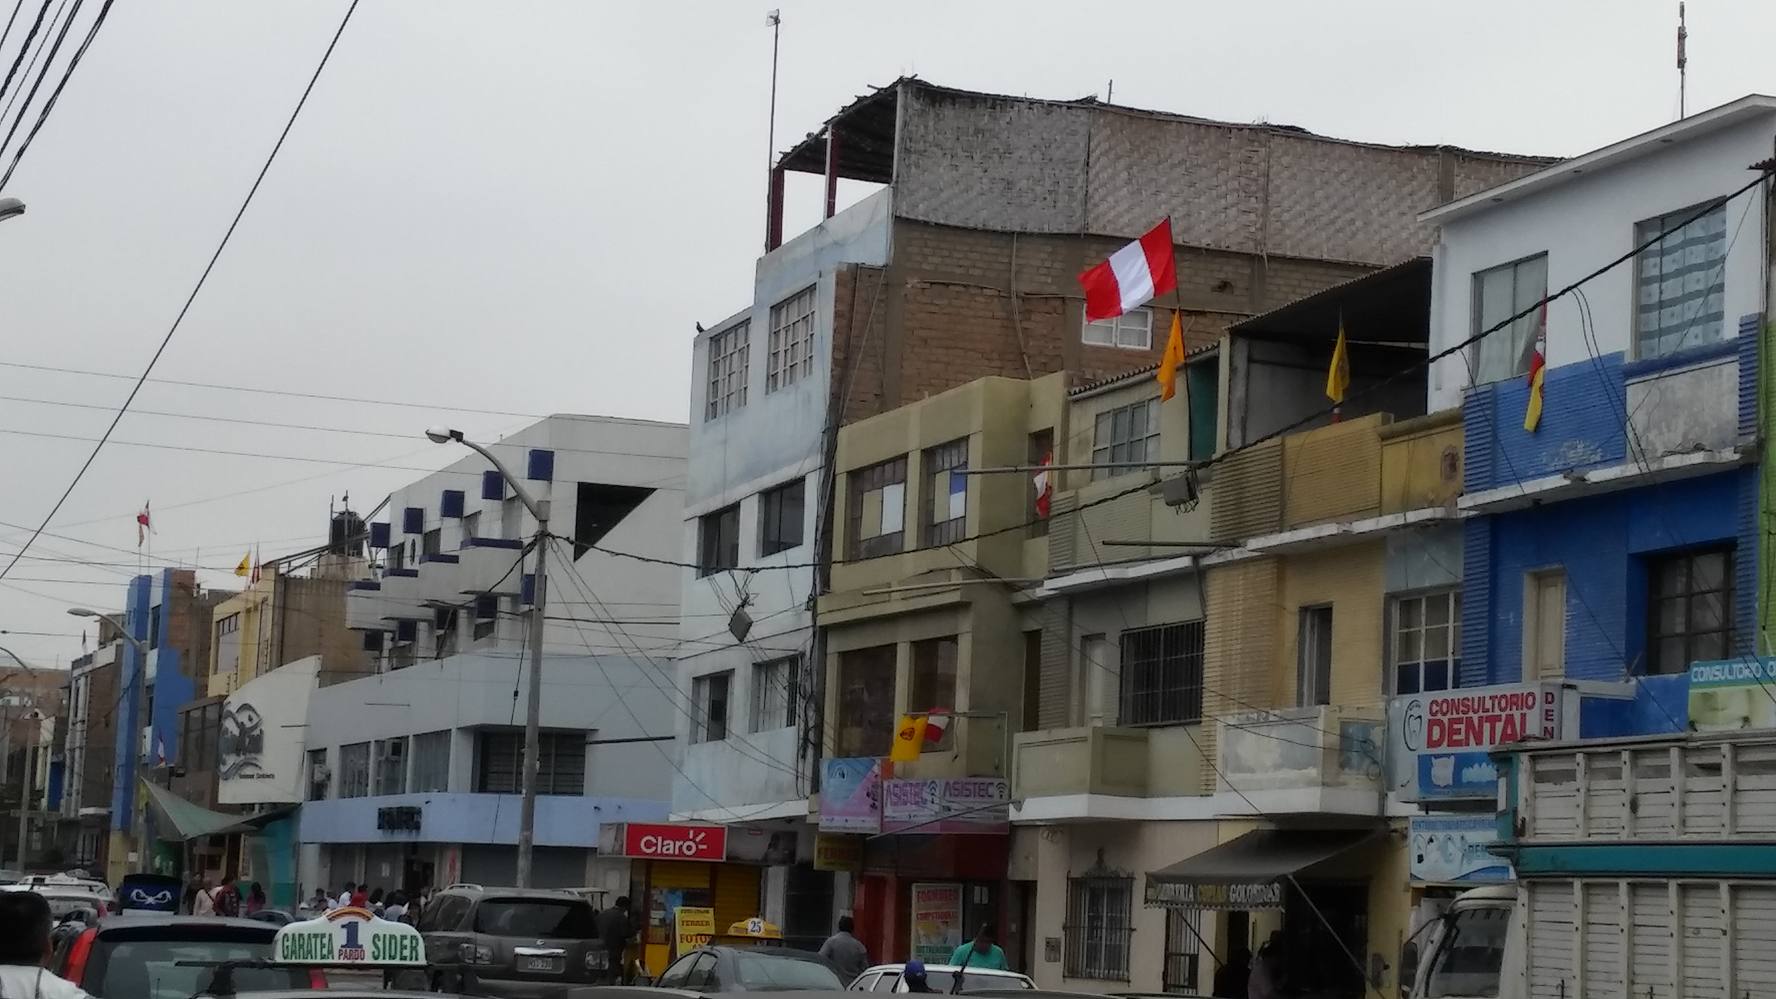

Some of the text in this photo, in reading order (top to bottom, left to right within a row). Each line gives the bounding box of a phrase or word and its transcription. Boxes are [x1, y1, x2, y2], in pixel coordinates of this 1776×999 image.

[1691, 663, 1761, 682] CONSULTORIO
[1429, 692, 1536, 717] CONSULTORIO
[1427, 714, 1527, 749] DENTAL
[943, 782, 994, 799] ASISTEC
[640, 835, 697, 856] Claro
[340, 921, 363, 949] 1
[750, 920, 762, 934] 25
[282, 933, 419, 961] GARATEA SIDER
[338, 949, 365, 961] PARDO
